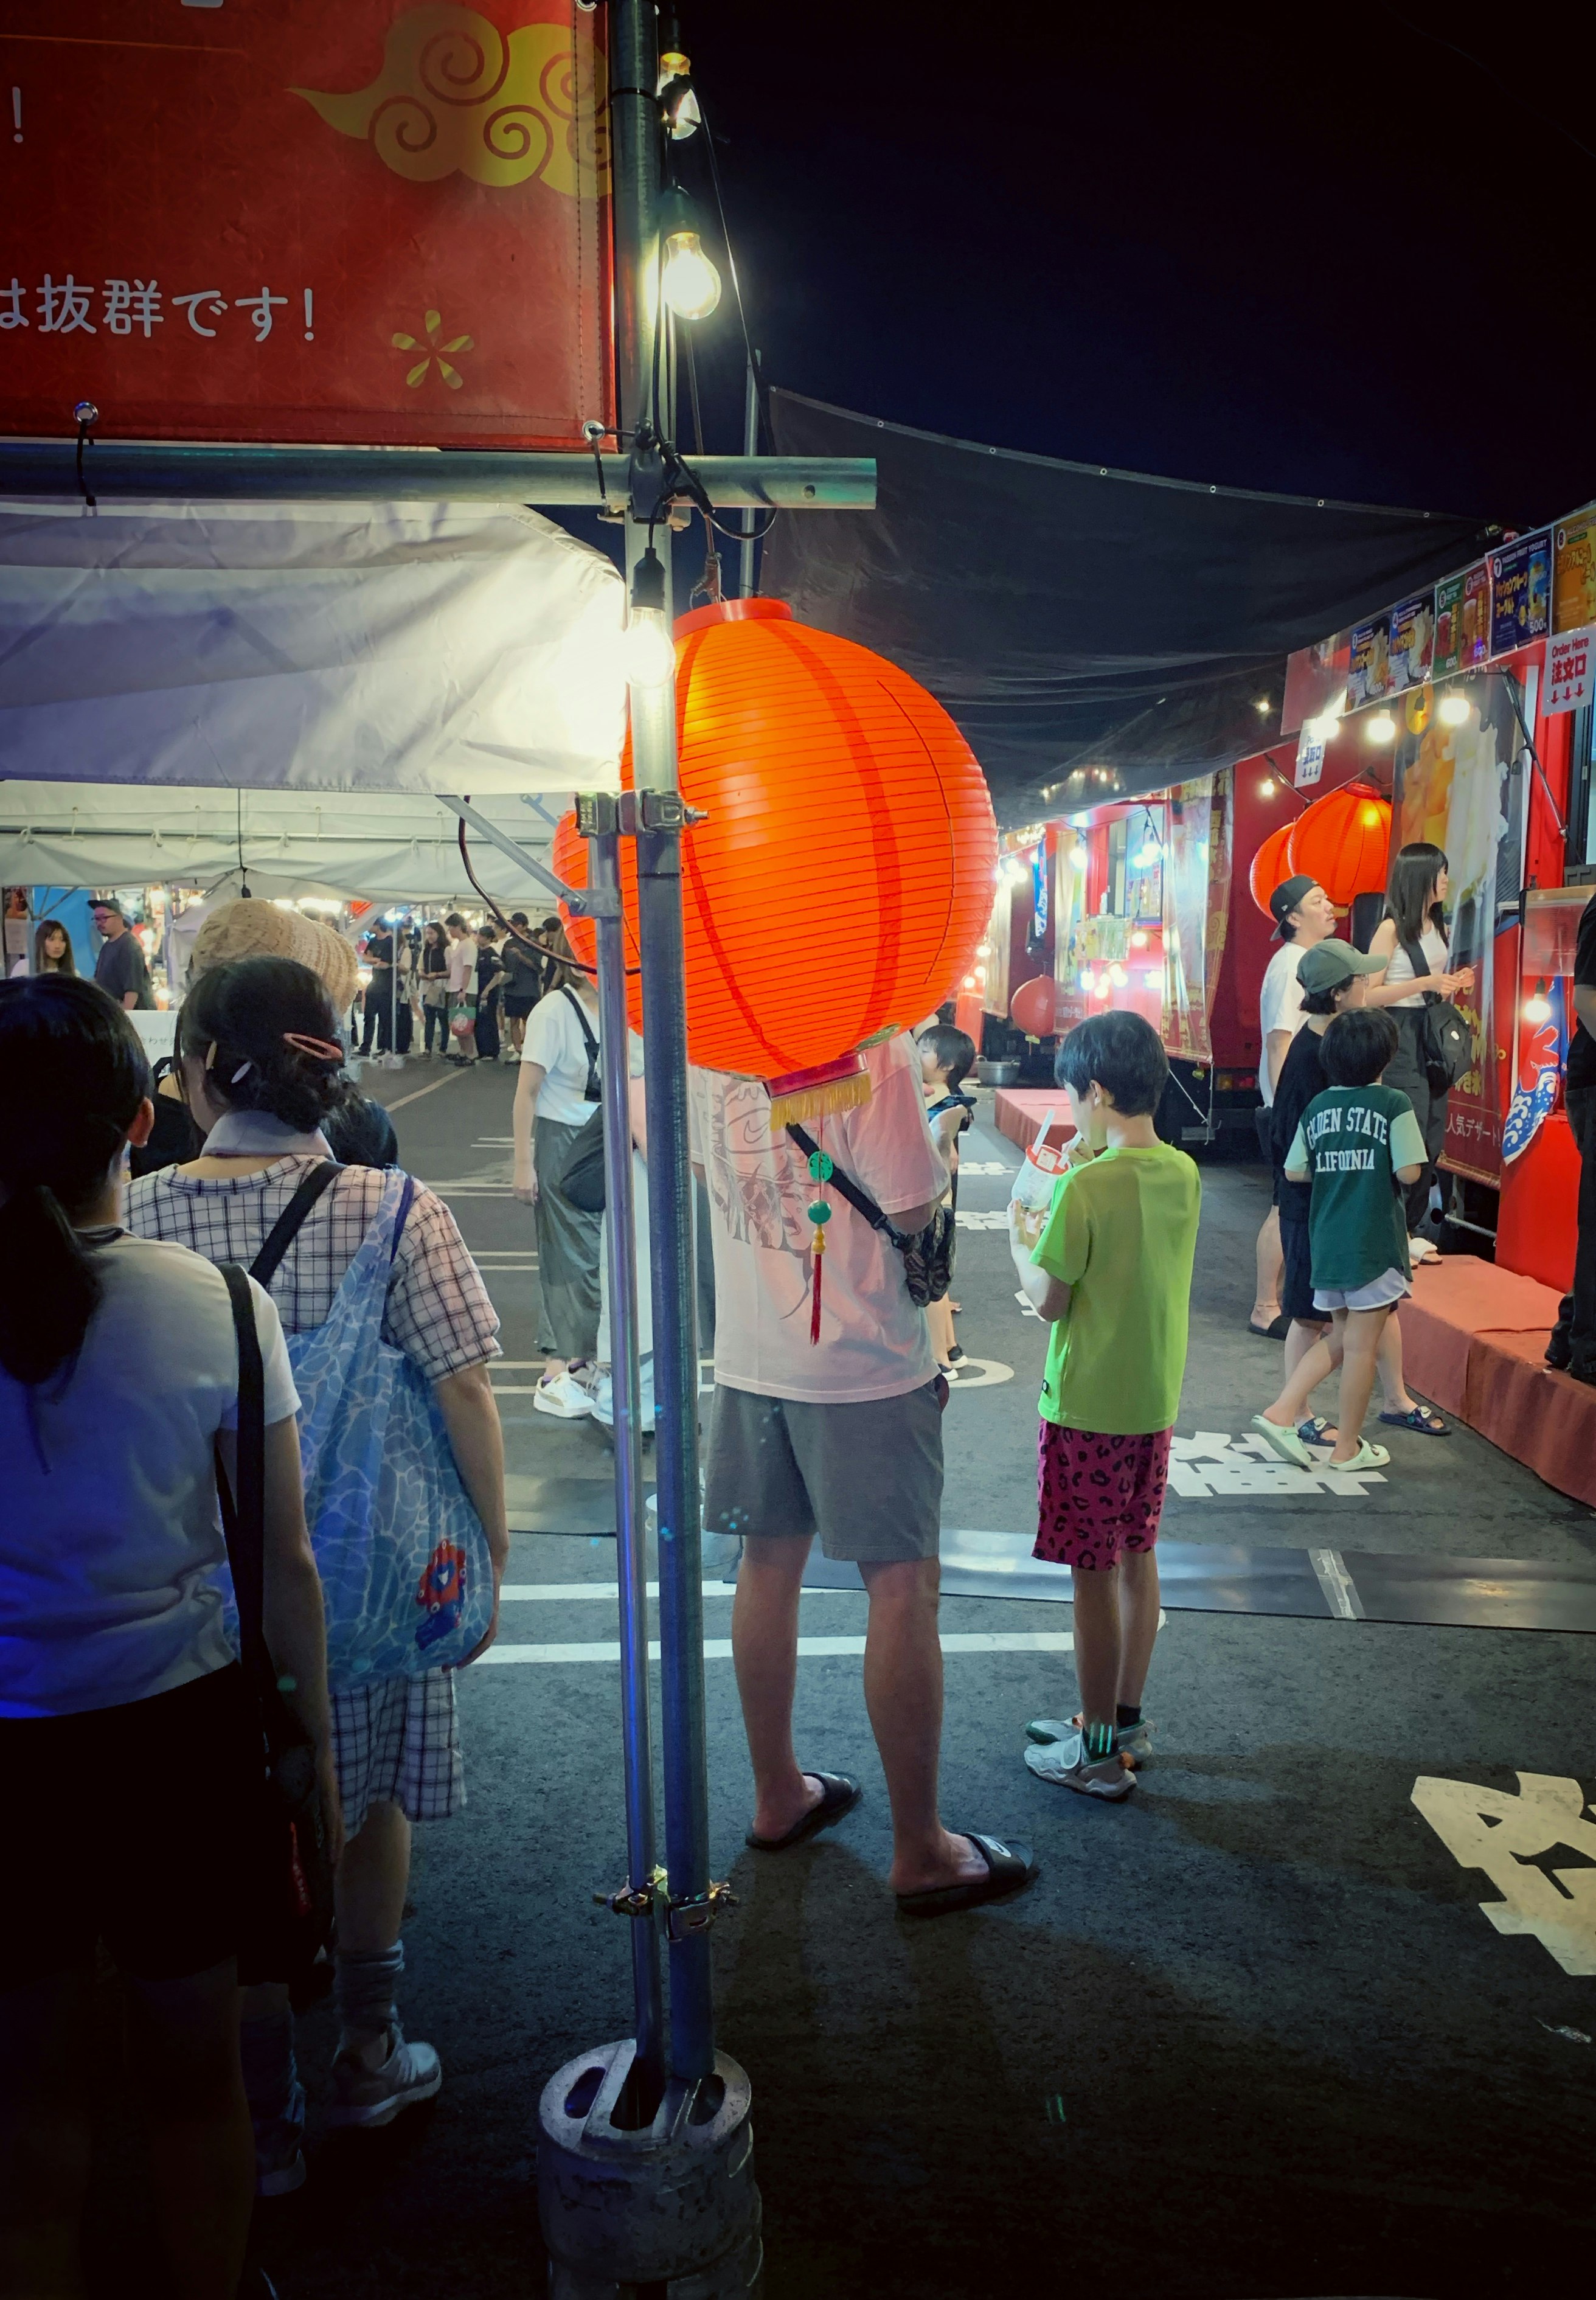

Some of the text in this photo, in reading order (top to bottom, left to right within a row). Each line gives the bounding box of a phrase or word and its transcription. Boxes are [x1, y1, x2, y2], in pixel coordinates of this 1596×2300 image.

[1552, 637, 1589, 658] Order Here
[1551, 653, 1587, 686] 注文口
[1345, 1107, 1388, 1145] STATE
[1315, 1148, 1375, 1173] LIFORNIA
